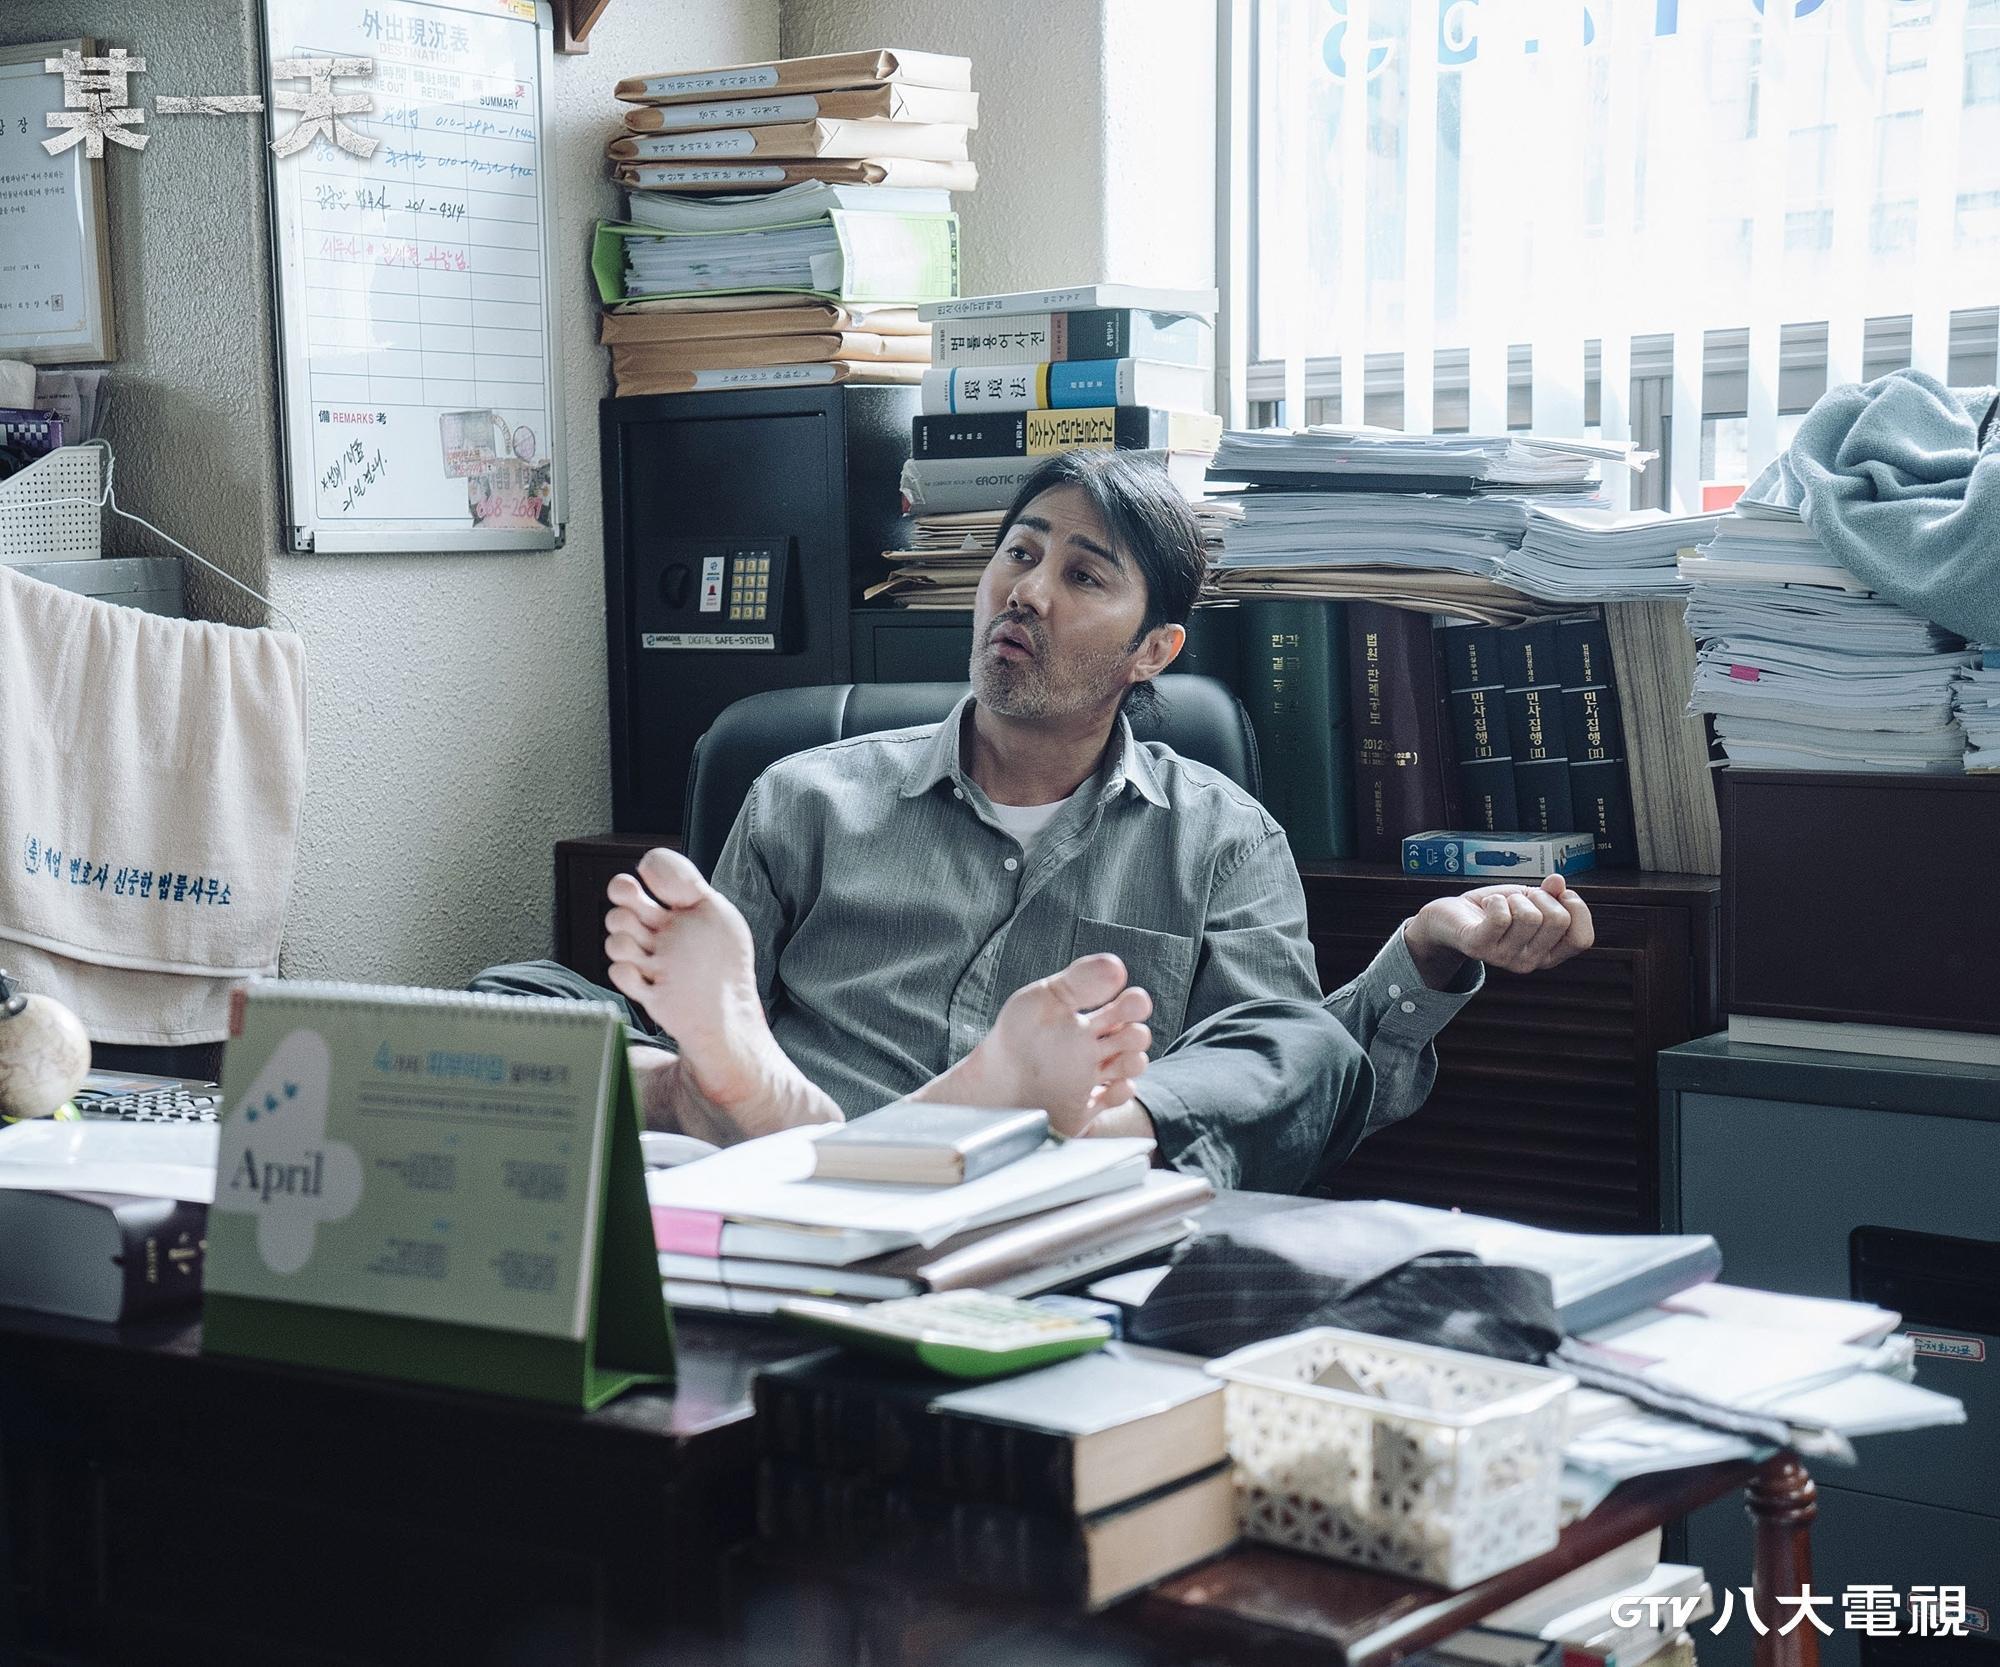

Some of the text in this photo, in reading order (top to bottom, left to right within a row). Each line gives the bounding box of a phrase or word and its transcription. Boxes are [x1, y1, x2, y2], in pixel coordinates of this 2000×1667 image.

[479, 96, 520, 110] SUMMARY
[951, 330, 1045, 351] 법률용어사전
[964, 377, 1027, 400] 環境法
[333, 412, 374, 424] REMARKS
[1029, 416, 1113, 448] 건설관련소송
[975, 474, 1014, 487] EROTIC
[688, 636, 769, 645] DIGITAL SAFE-SYSTEM
[1471, 692, 1488, 745] 민사집행
[1526, 692, 1543, 746] 민사집행
[1584, 692, 1600, 746] 민사집행
[69, 857, 109, 891] 변호사
[114, 866, 153, 898] 신중한
[158, 872, 232, 905] 법률사무소
[230, 1147, 325, 1203] April
